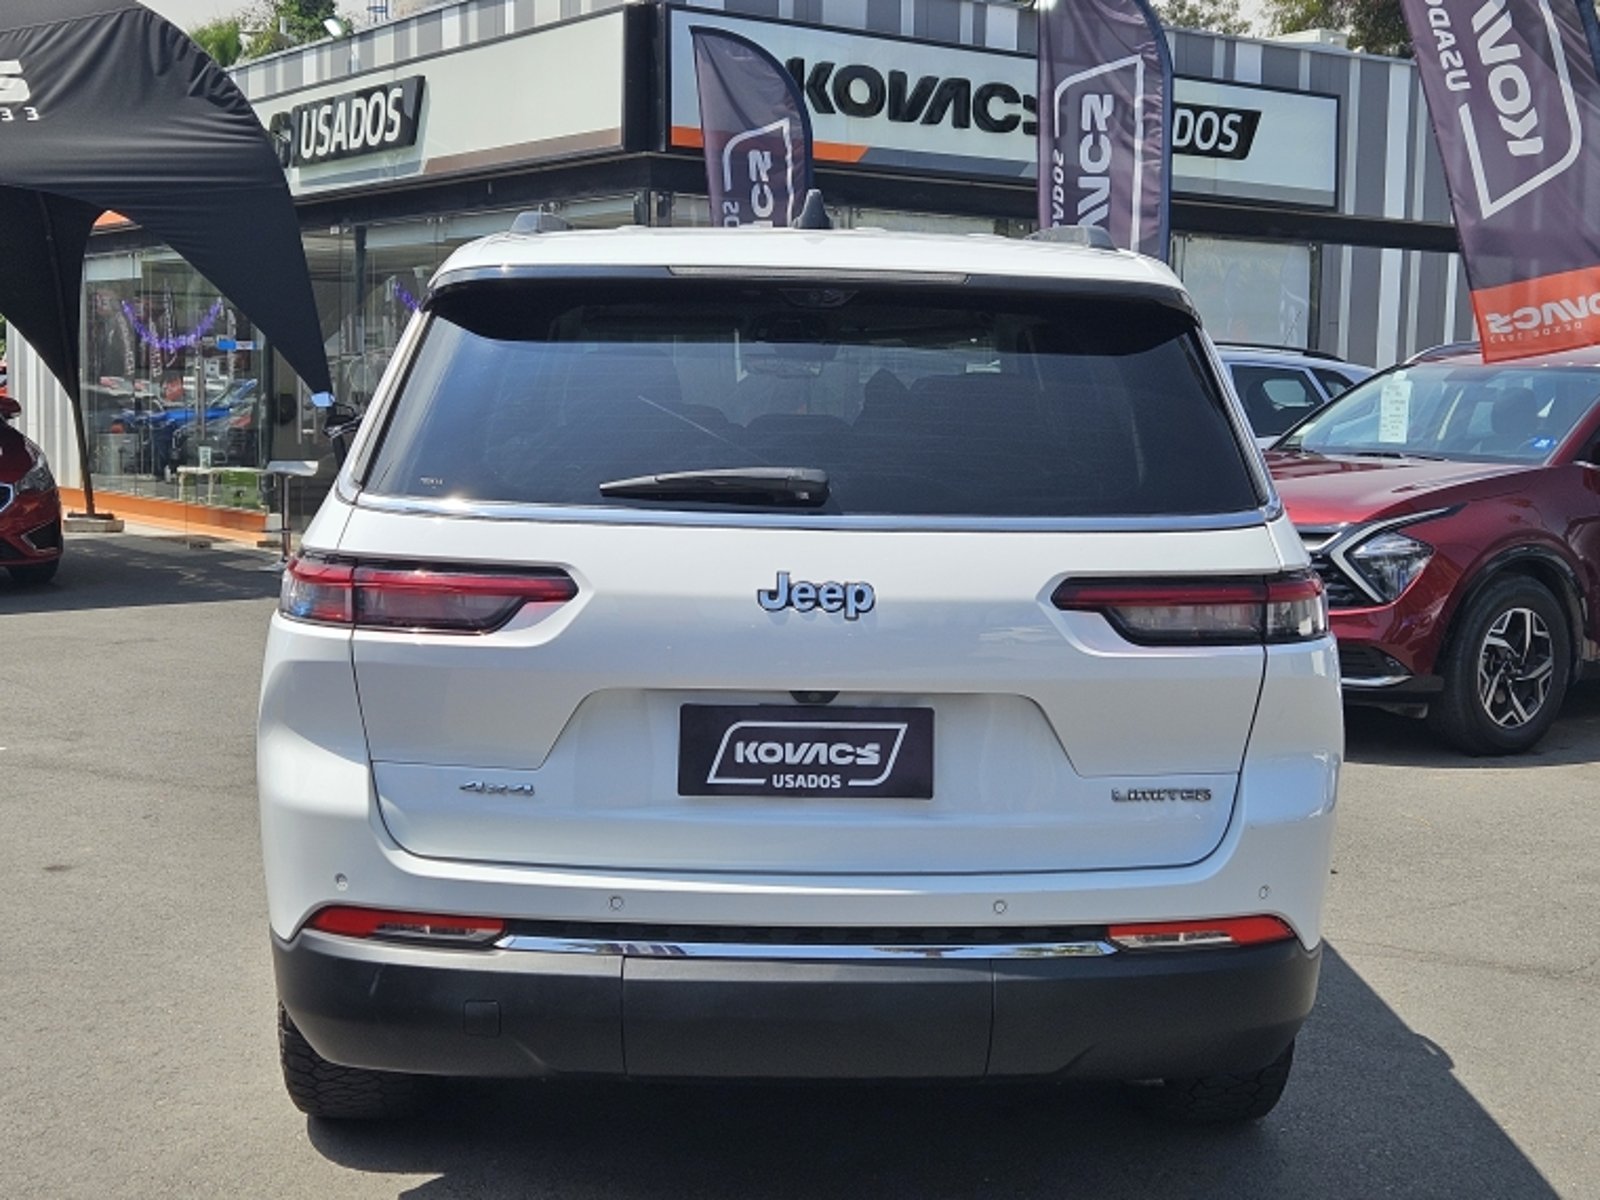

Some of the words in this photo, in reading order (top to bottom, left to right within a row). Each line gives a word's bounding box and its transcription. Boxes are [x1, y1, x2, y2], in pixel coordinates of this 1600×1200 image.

[301, 87, 403, 159] USADOS
[757, 571, 876, 621] Jeep
[734, 741, 881, 766] KOVACS
[772, 774, 842, 789] USADOS
